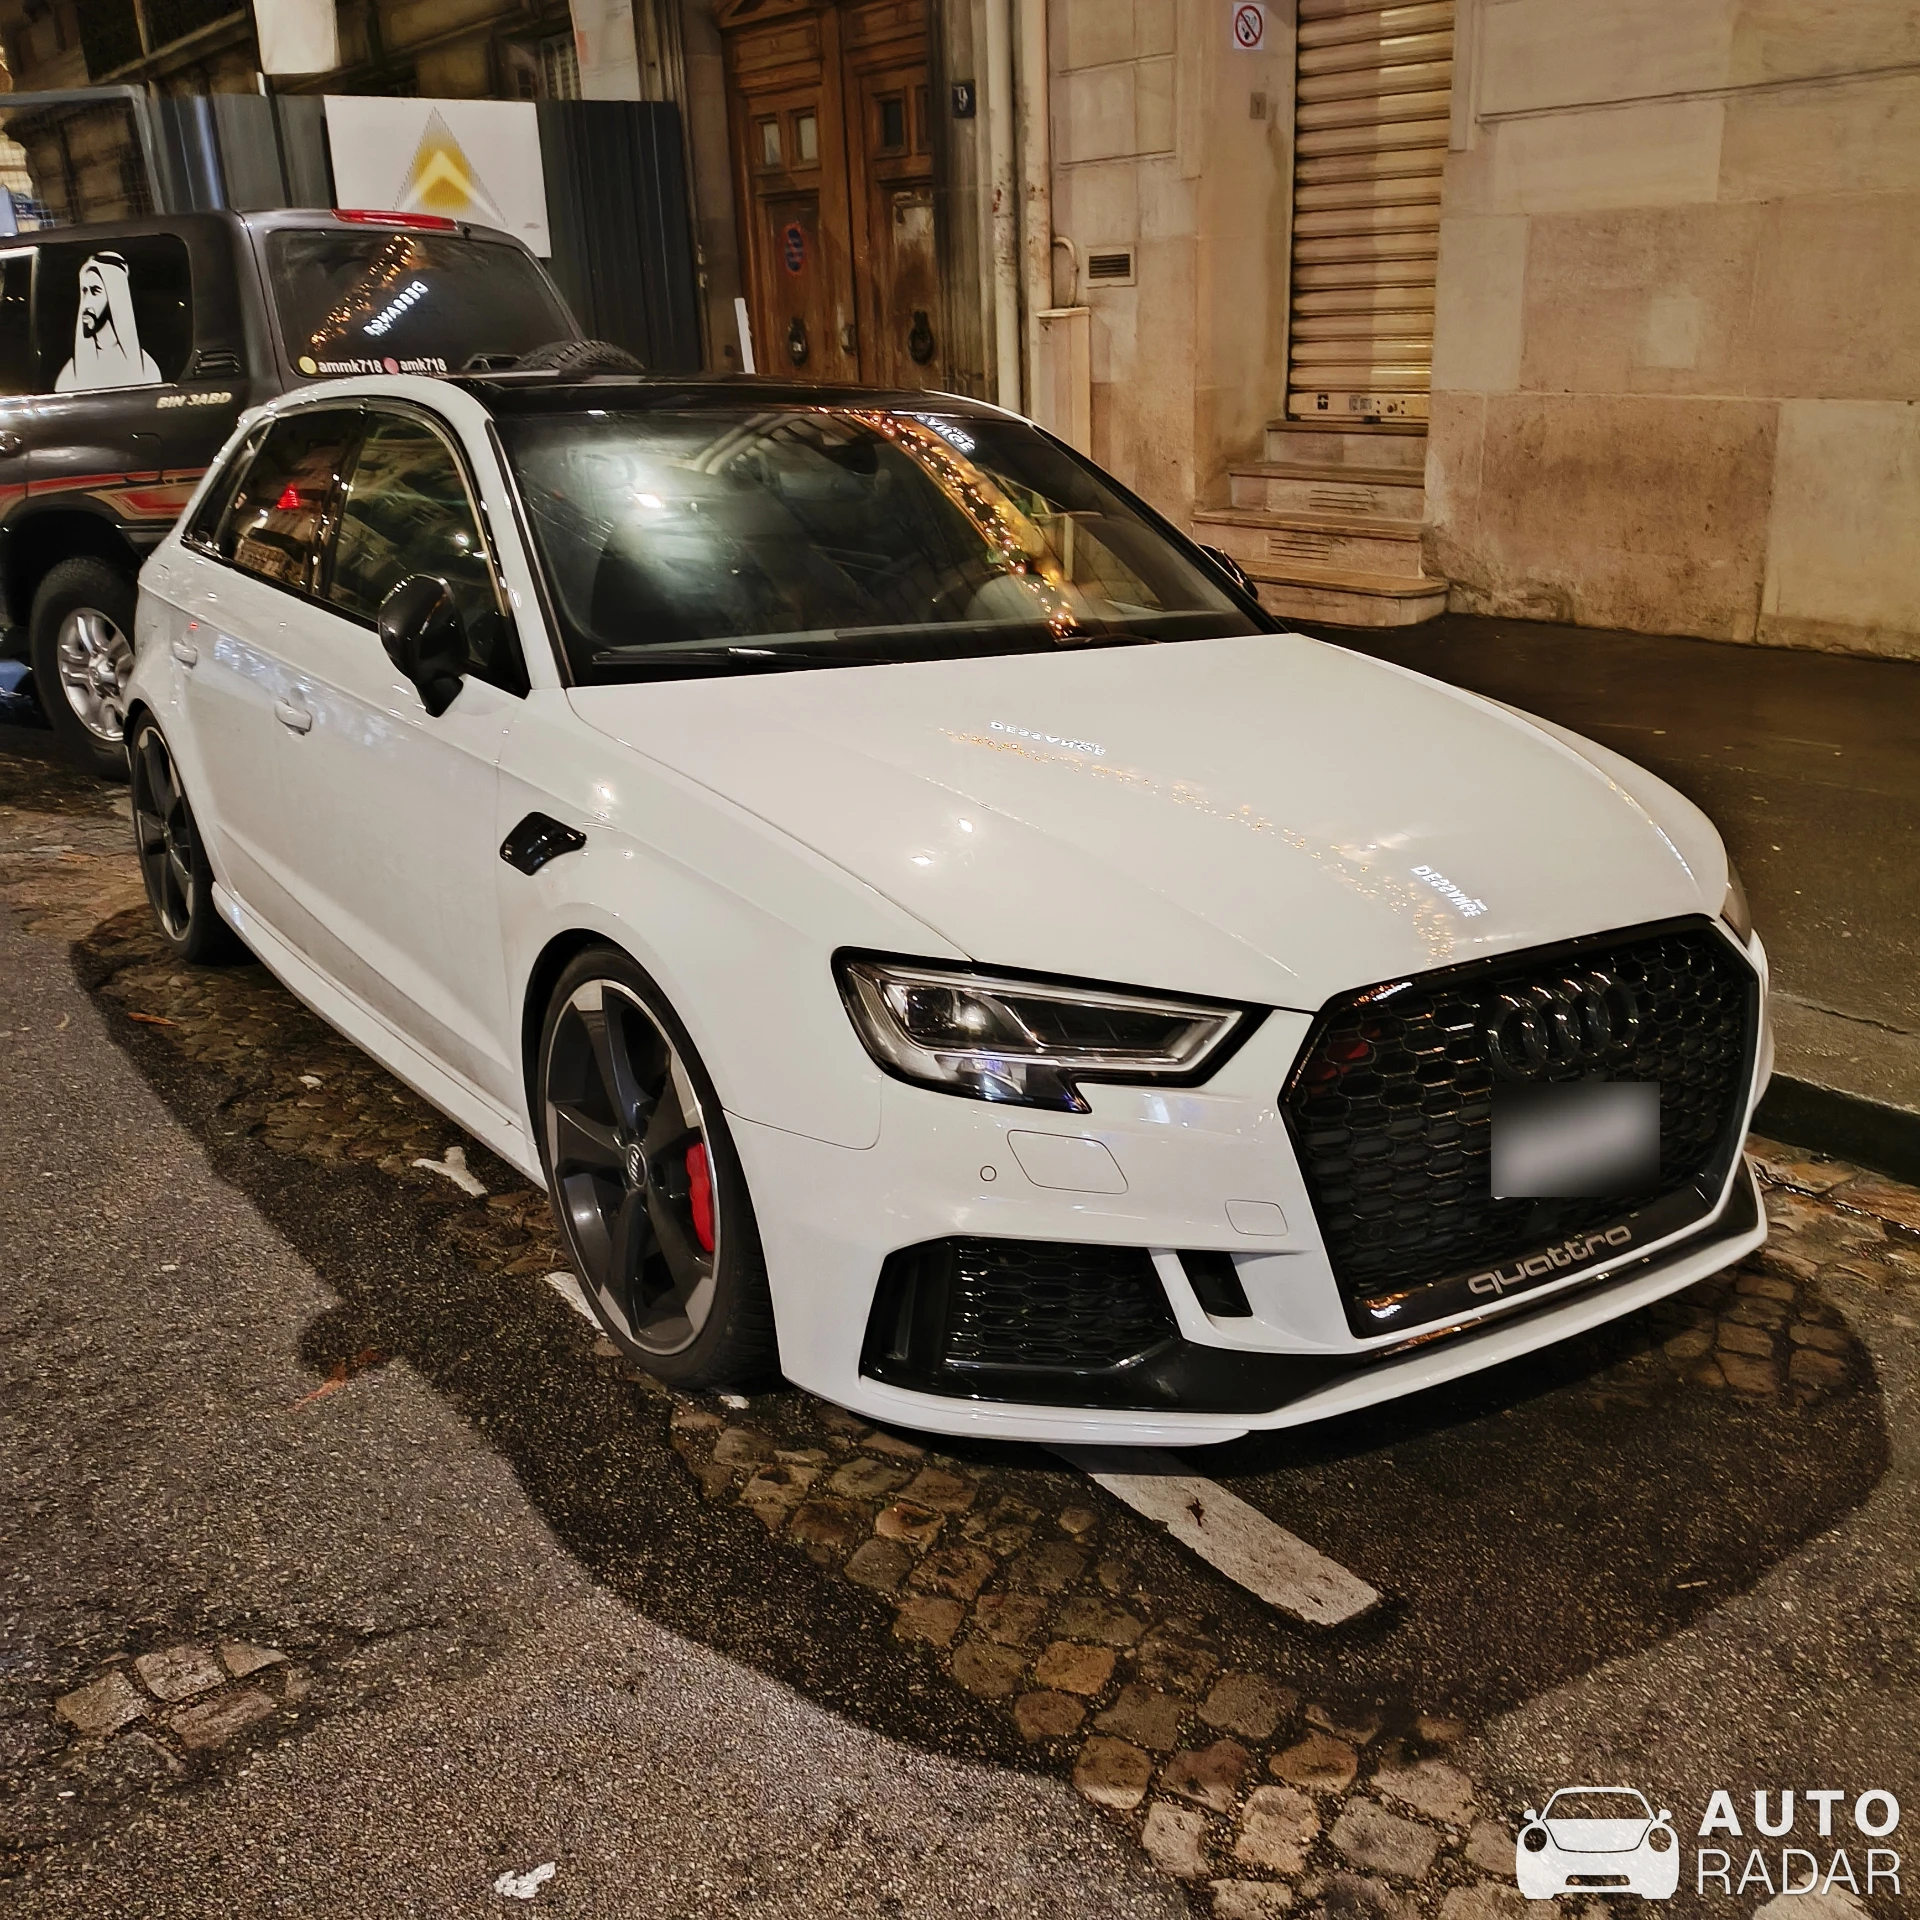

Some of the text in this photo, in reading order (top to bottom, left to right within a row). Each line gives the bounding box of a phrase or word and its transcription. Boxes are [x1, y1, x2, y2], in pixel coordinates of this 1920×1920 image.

[318, 357, 447, 373] ammk718 amk718
[1467, 1225, 1632, 1294] quattro
